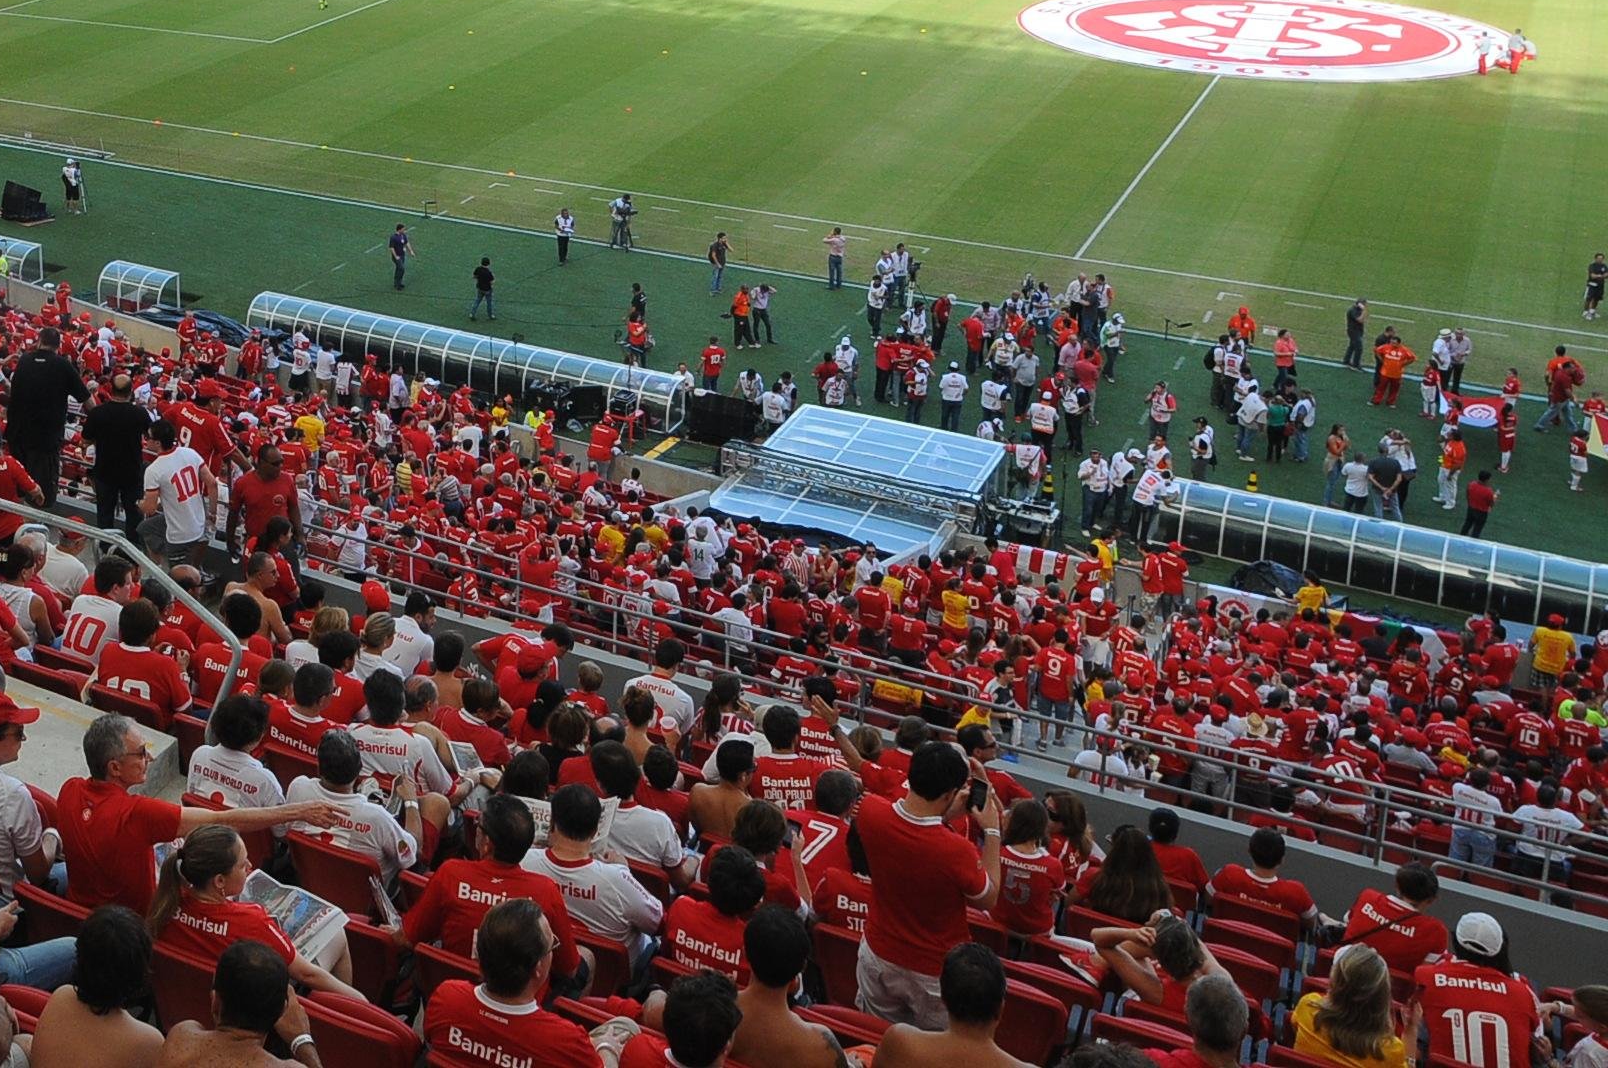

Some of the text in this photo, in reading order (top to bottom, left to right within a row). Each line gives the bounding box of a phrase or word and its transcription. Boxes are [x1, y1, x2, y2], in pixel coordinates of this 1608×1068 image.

[179, 426, 192, 448] 9
[170, 465, 200, 504] 10
[694, 548, 705, 562] 14
[706, 595, 716, 612] 7
[63, 612, 107, 656] 10
[1048, 658, 1062, 676] 9
[1177, 669, 1190, 685] 5
[1519, 728, 1540, 747] 10
[1569, 733, 1583, 747] 11
[357, 739, 408, 757] Banrisul
[203, 767, 220, 781] CLUB
[219, 772, 243, 790] WORLD
[243, 782, 258, 795] CUP
[762, 776, 811, 788] Banrisul
[763, 789, 813, 801] JOÃO PAULO
[354, 821, 372, 834] CUP
[800, 819, 839, 866] 7
[1003, 868, 1032, 906] 5
[675, 928, 741, 966] Banrisul
[1434, 973, 1508, 995] Banrisul
[448, 1025, 533, 1068] Banrisul
[1442, 1007, 1511, 1068] 10
